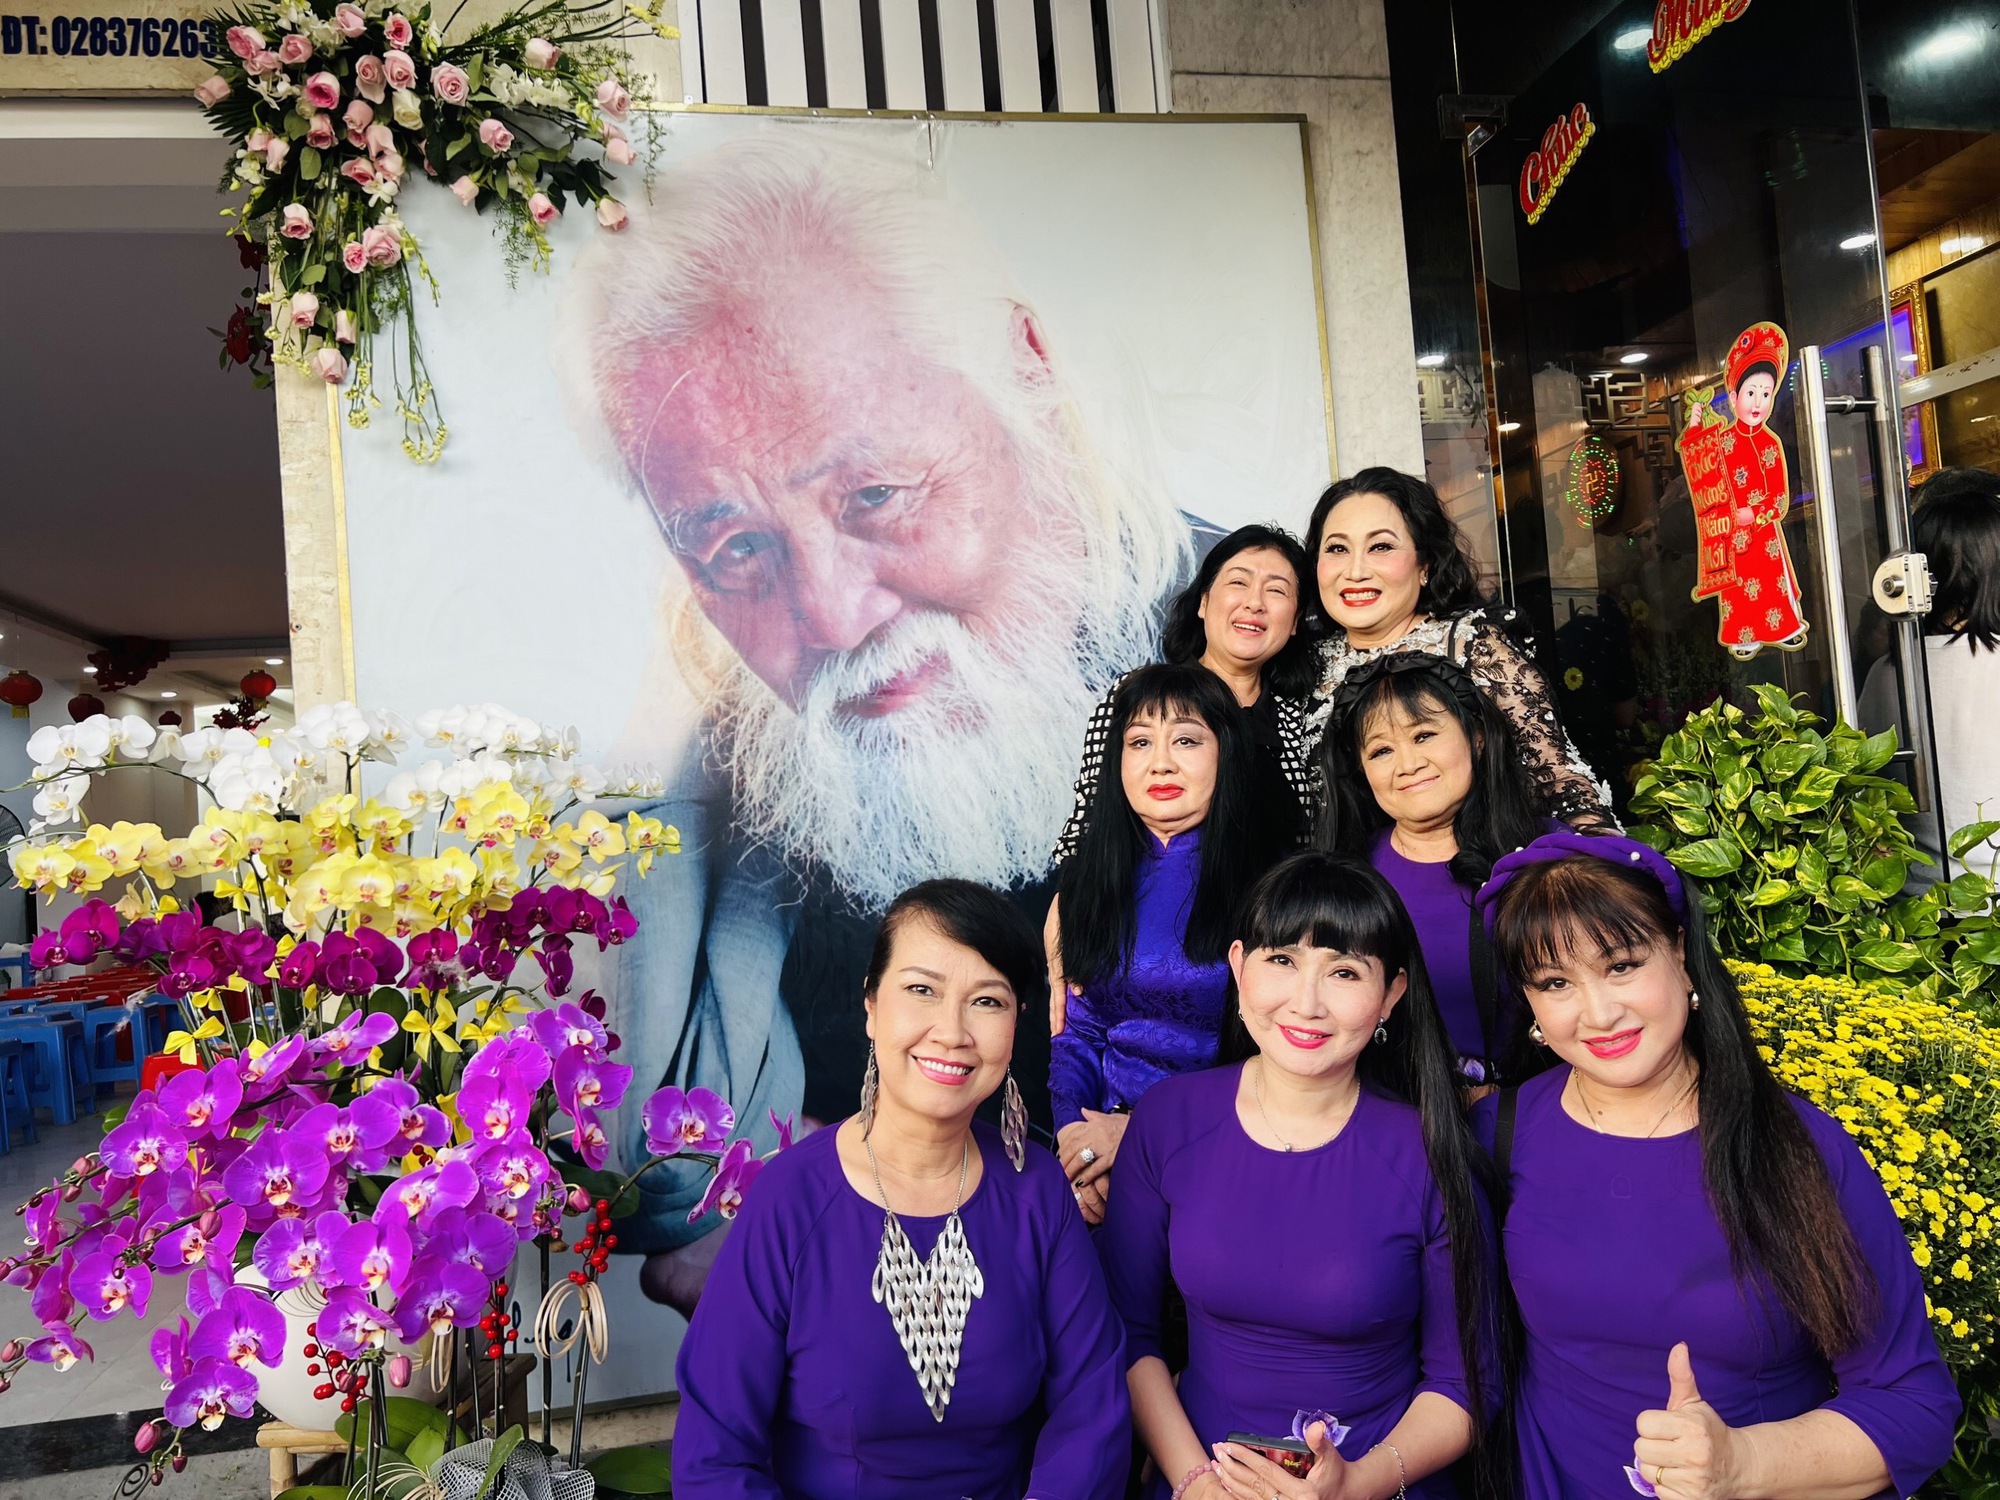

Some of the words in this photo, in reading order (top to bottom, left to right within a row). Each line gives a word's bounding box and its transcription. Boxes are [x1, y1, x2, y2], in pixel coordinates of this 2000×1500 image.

[1, 15, 48, 55] ĐT:
[1519, 102, 1591, 212] Chúc
[1702, 512, 1730, 538] Năm
[1703, 542, 1725, 567] Mới
